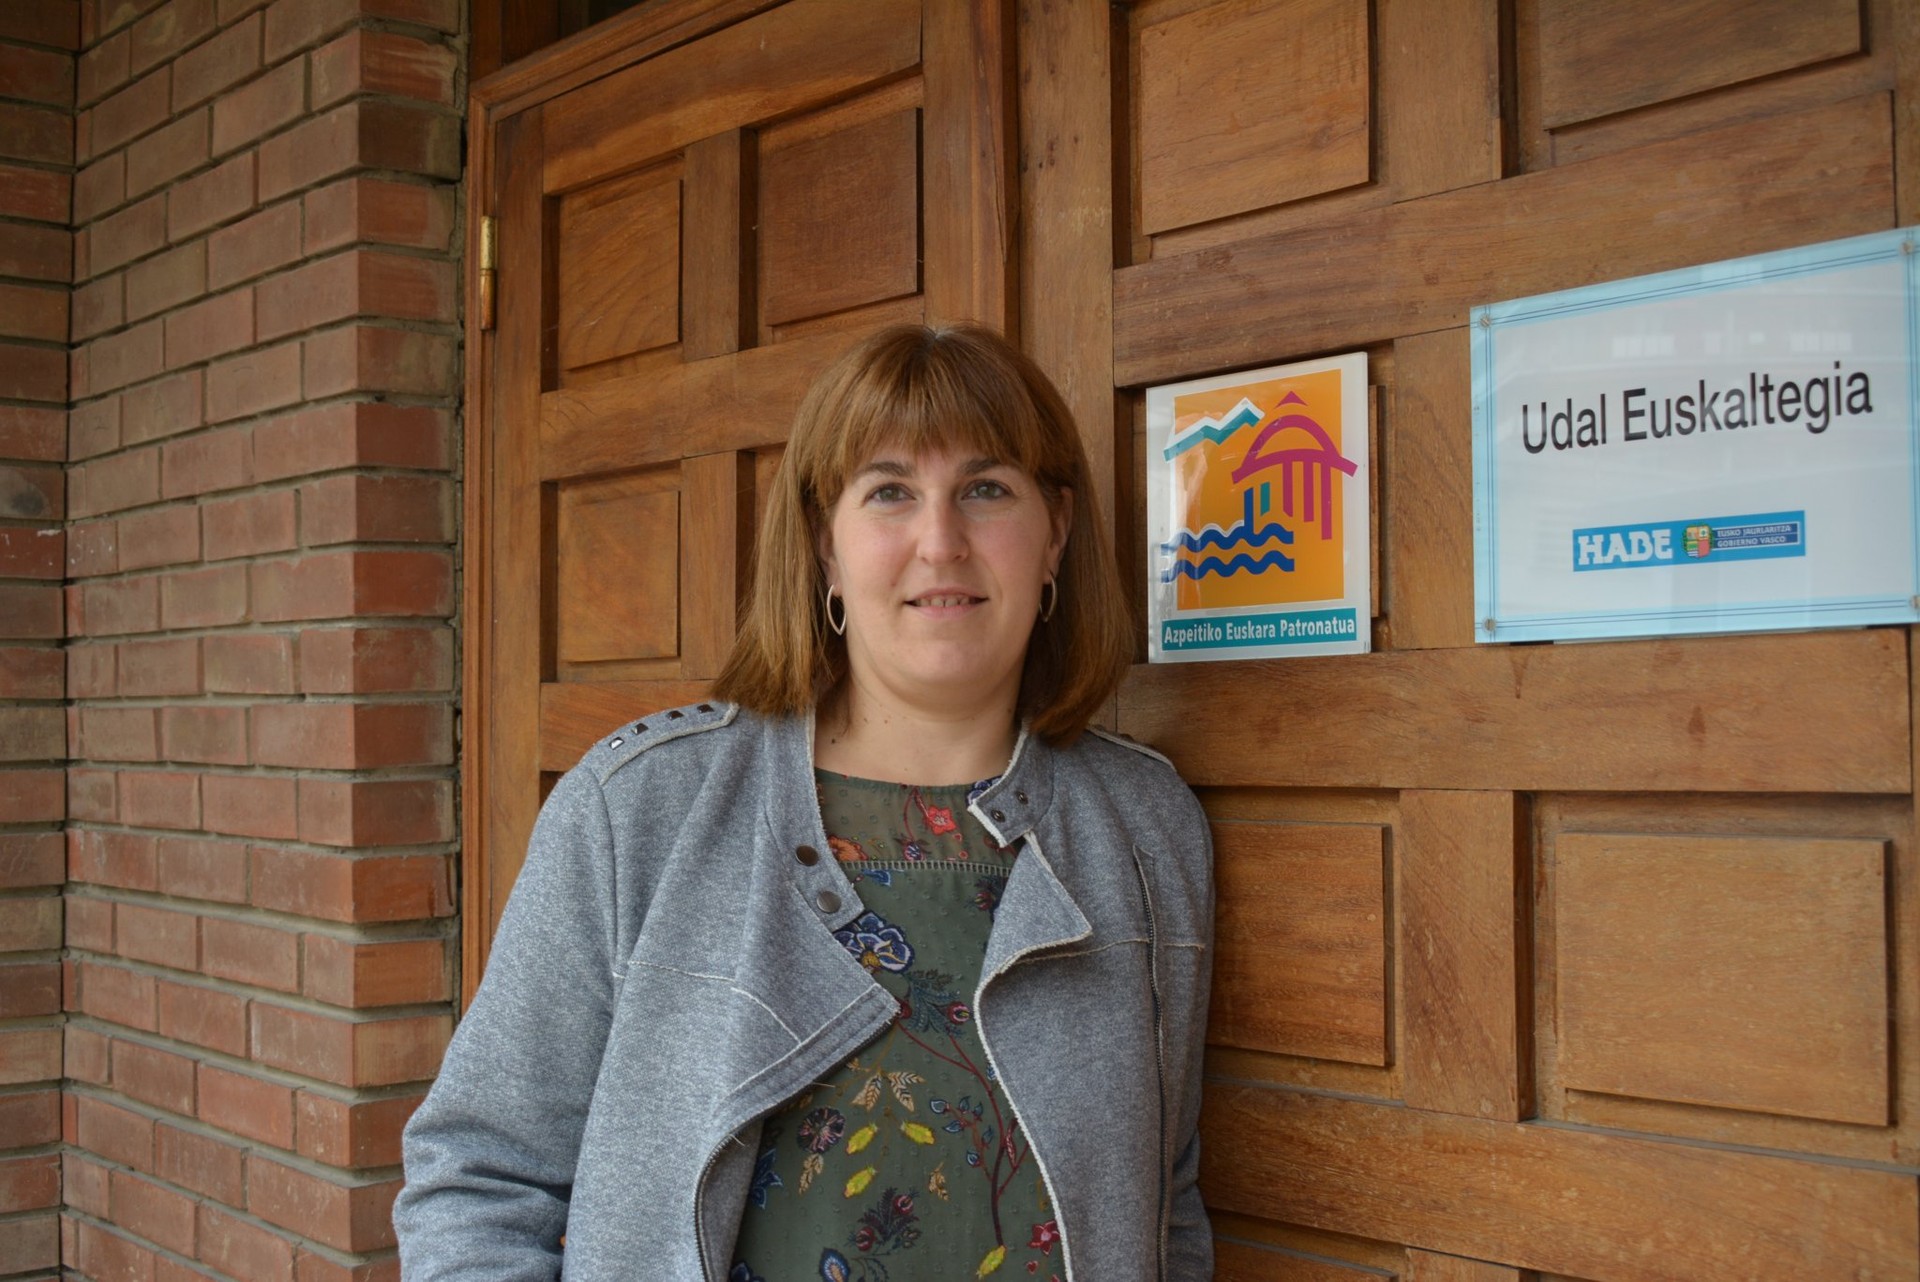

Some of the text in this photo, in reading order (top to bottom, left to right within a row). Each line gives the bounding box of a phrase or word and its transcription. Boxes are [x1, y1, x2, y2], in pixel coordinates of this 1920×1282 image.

[1521, 361, 1873, 454] Udal Euskaltegia
[1717, 525, 1791, 537] EUSKO JAURLARITZA
[1717, 536, 1786, 548] GOBIERNO VASCO
[1577, 528, 1673, 566] HABE
[1164, 616, 1355, 647] Azpeitiko Euskara Patronatua
